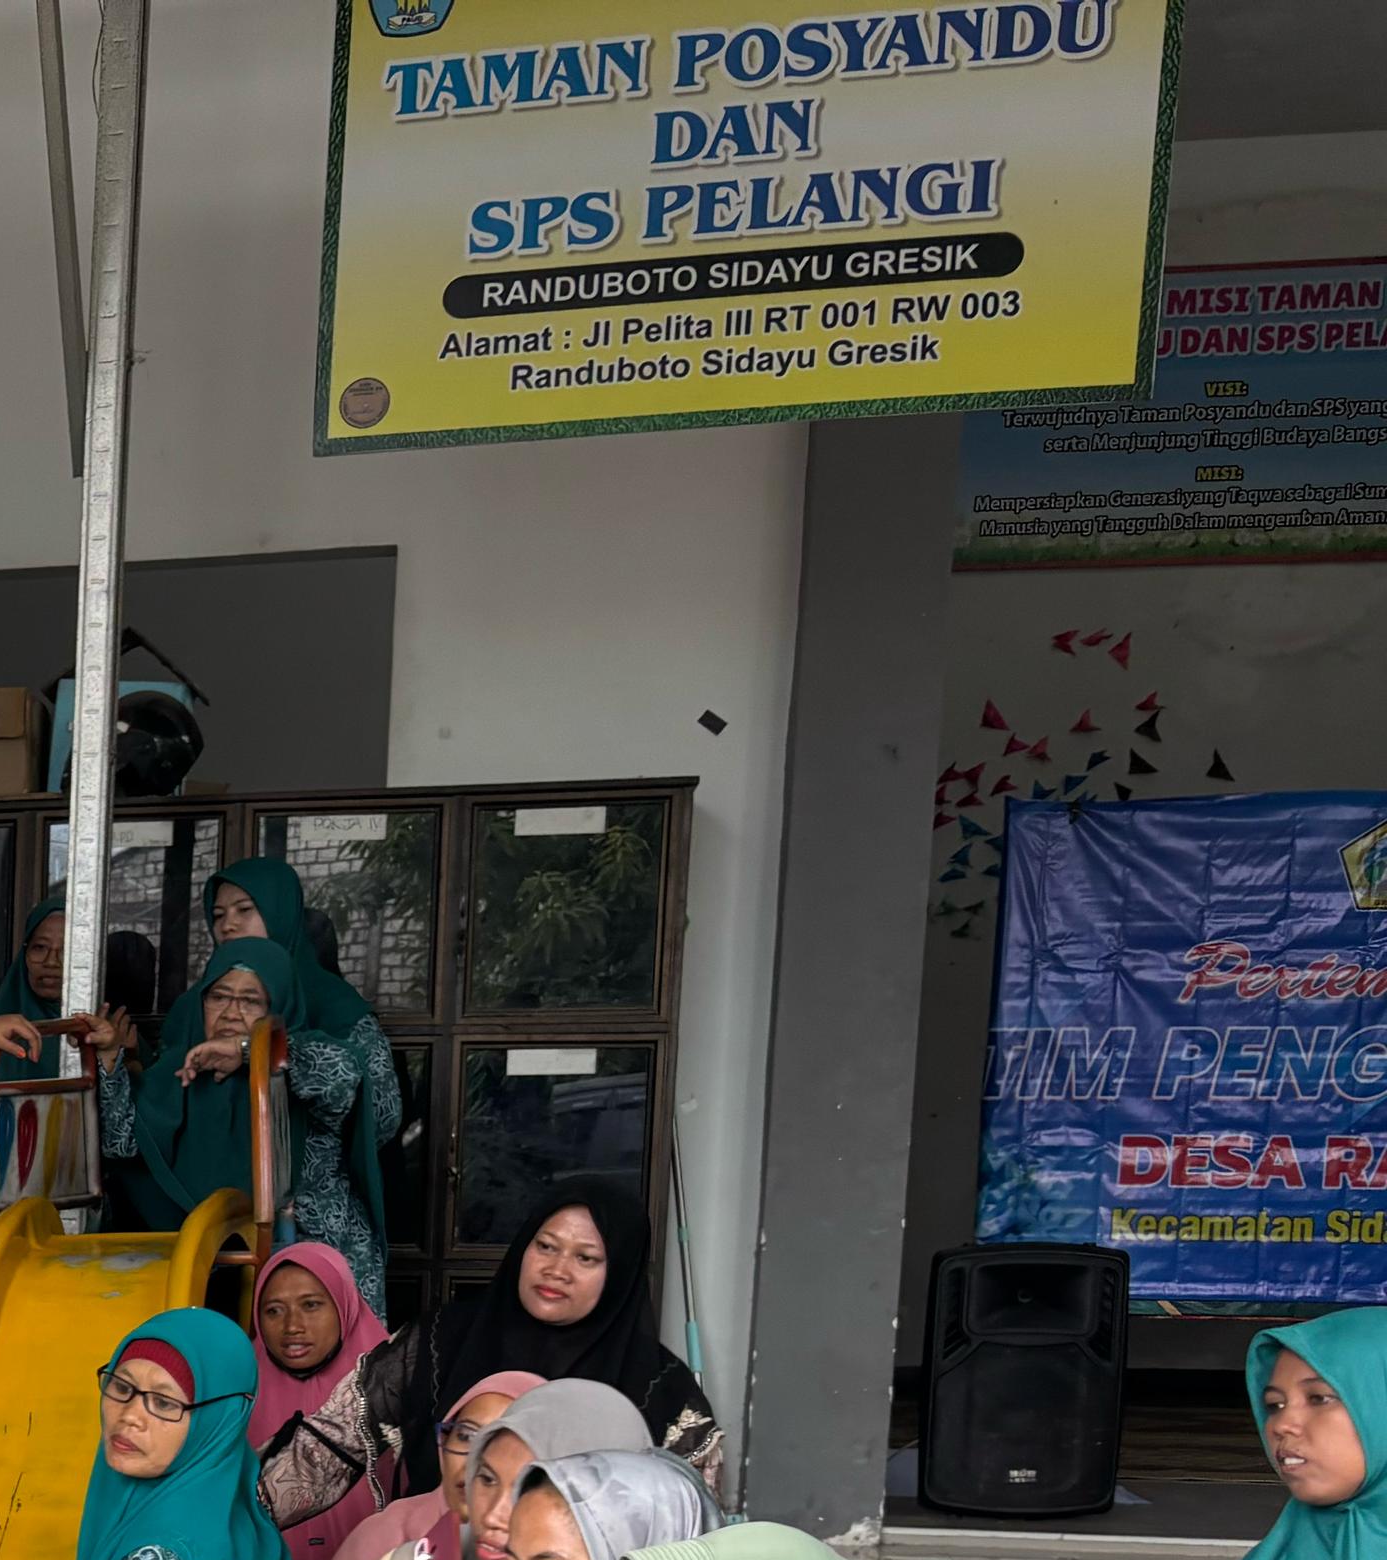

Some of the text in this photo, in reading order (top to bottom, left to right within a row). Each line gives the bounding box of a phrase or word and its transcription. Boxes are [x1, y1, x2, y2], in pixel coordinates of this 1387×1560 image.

[384, 0, 1110, 117] TAMAN POSYANDU
[650, 98, 815, 164] DAN
[468, 158, 997, 256] SPS PELANGI
[482, 242, 980, 308] RANDUBOTO SIDAYU GRESIK
[1165, 280, 1382, 316] MISI TAMAN
[438, 326, 553, 360] Alamat
[622, 313, 713, 345] Pelita
[724, 308, 752, 337] III
[763, 304, 811, 334] RT
[820, 299, 877, 329] 001
[890, 294, 952, 325] RW
[960, 290, 1021, 319] 003
[1179, 326, 1250, 355] DAN
[1255, 323, 1317, 352] SPS
[510, 334, 940, 391] Randuboto Sidayu Gresik
[1205, 381, 1249, 397] VISI:
[1003, 407, 1117, 429] Terwujudnya
[1120, 405, 1181, 424] Taman
[1183, 400, 1272, 424] Posyandu
[1273, 400, 1308, 418] dan
[1311, 397, 1347, 416] SPS
[1043, 436, 1088, 453] serta
[1091, 431, 1201, 454] Menjunjung
[1202, 428, 1260, 451] Tinggi
[1263, 426, 1328, 448] Budaya
[1196, 465, 1244, 482] MISI:
[973, 490, 1106, 514] Mempersiapkan
[1109, 488, 1181, 508] Generasi
[1182, 490, 1226, 509] yang
[1228, 486, 1284, 507] Taqwa
[1286, 483, 1353, 504] sebagai
[979, 507, 1387, 538] Manusia yang Tangguh Dalam mengemban Aman
[983, 1026, 1137, 1101] TIM
[1116, 1133, 1307, 1191] DESA
[1109, 1205, 1387, 1245] Kecamatan Sid
